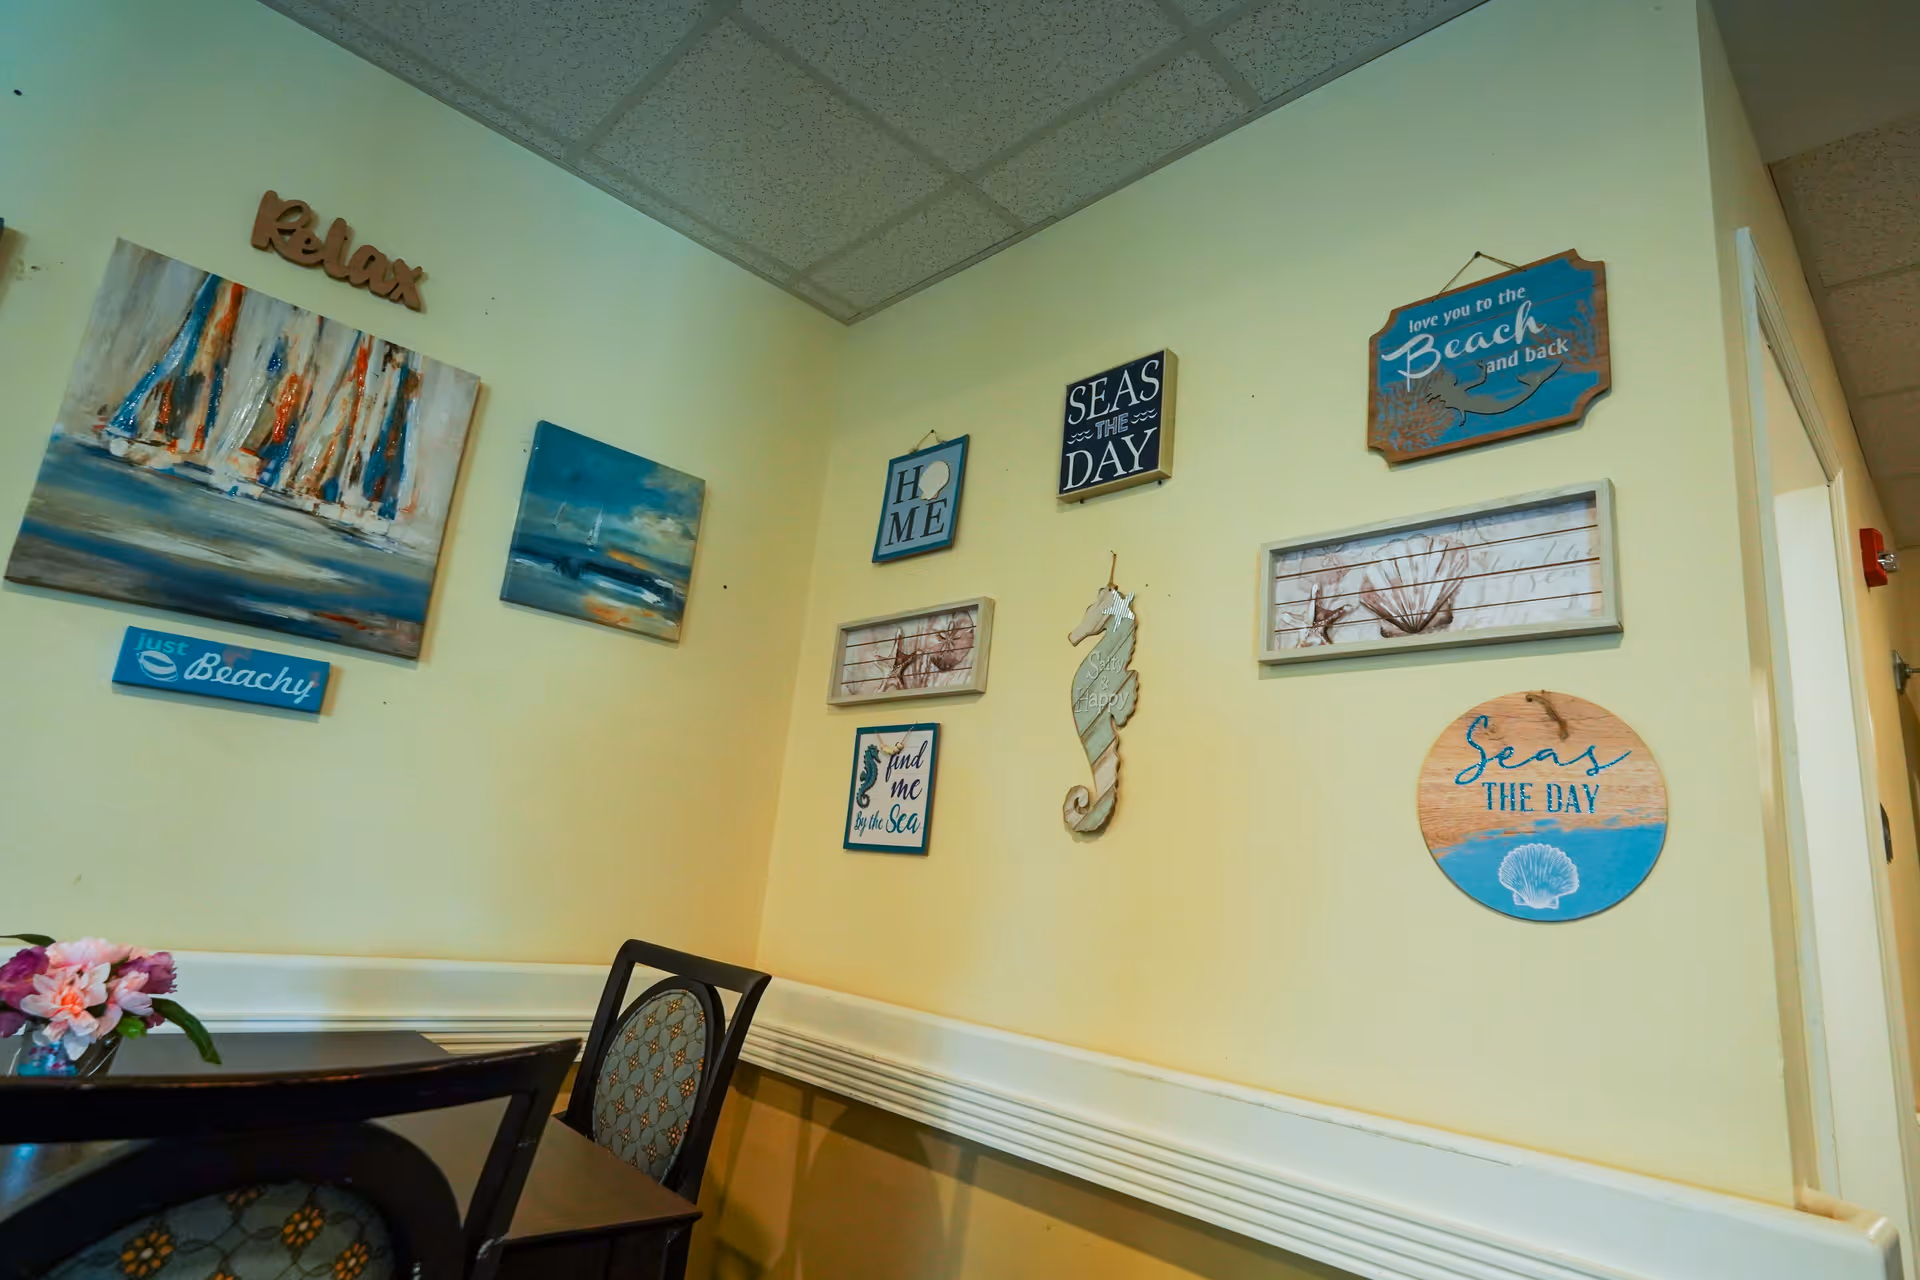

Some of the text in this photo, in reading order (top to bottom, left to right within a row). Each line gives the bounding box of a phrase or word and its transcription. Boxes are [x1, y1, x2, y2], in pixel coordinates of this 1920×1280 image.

[251, 190, 424, 312] Relax
[1409, 287, 1526, 333] love you to the
[1381, 300, 1547, 392] Beach
[1486, 338, 1569, 374] and back
[1068, 359, 1160, 425] SEAS
[1095, 412, 1129, 440] THE
[1063, 427, 1158, 491] DAY
[134, 633, 190, 655] just
[184, 652, 315, 704] Beachy
[1086, 651, 1124, 680] Salty
[1100, 675, 1110, 690] &
[1073, 687, 1131, 714] Happy
[1455, 715, 1632, 785] Seas
[890, 778, 923, 800] me
[1481, 782, 1600, 813] THE DAY
[868, 810, 884, 831] the
[885, 803, 921, 834] Sea
